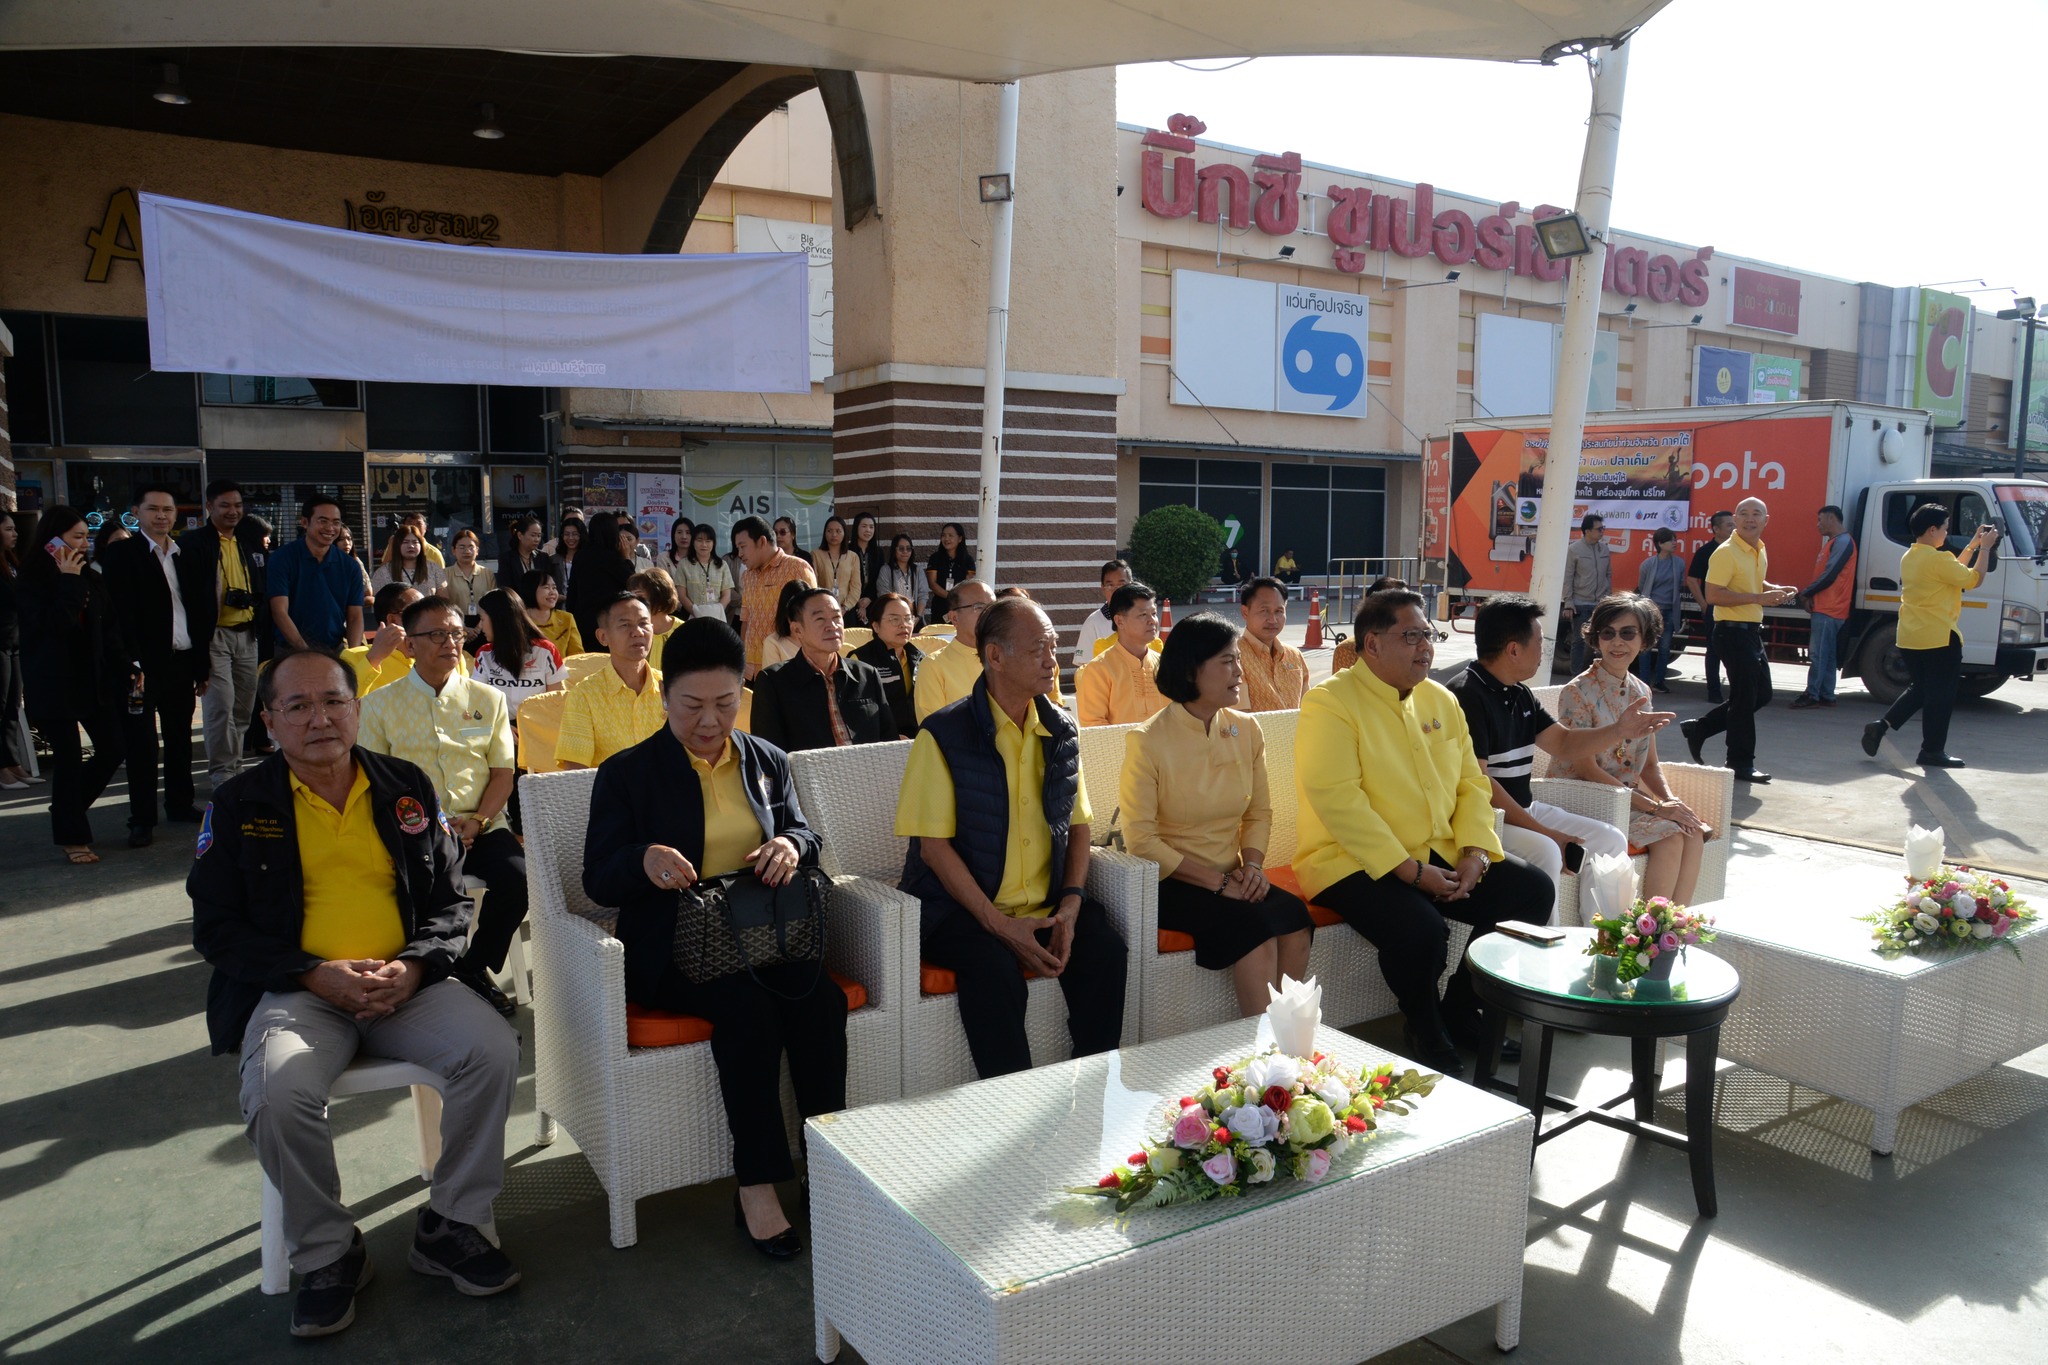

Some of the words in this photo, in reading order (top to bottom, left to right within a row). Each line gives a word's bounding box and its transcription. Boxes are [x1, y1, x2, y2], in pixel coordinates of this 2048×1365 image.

[1141, 113, 1302, 236] บิ๊กซี
[801, 233, 814, 247] Big
[801, 243, 832, 255] Service
[1285, 292, 1364, 317] แว่นท็อปเจริญ
[1661, 432, 1691, 448] ภาคใต้
[1643, 486, 1665, 497] บริโภค
[730, 495, 770, 515] AIS
[1643, 512, 1658, 520] ptt
[1224, 519, 1241, 549] 7
[487, 677, 545, 688] HONDA
